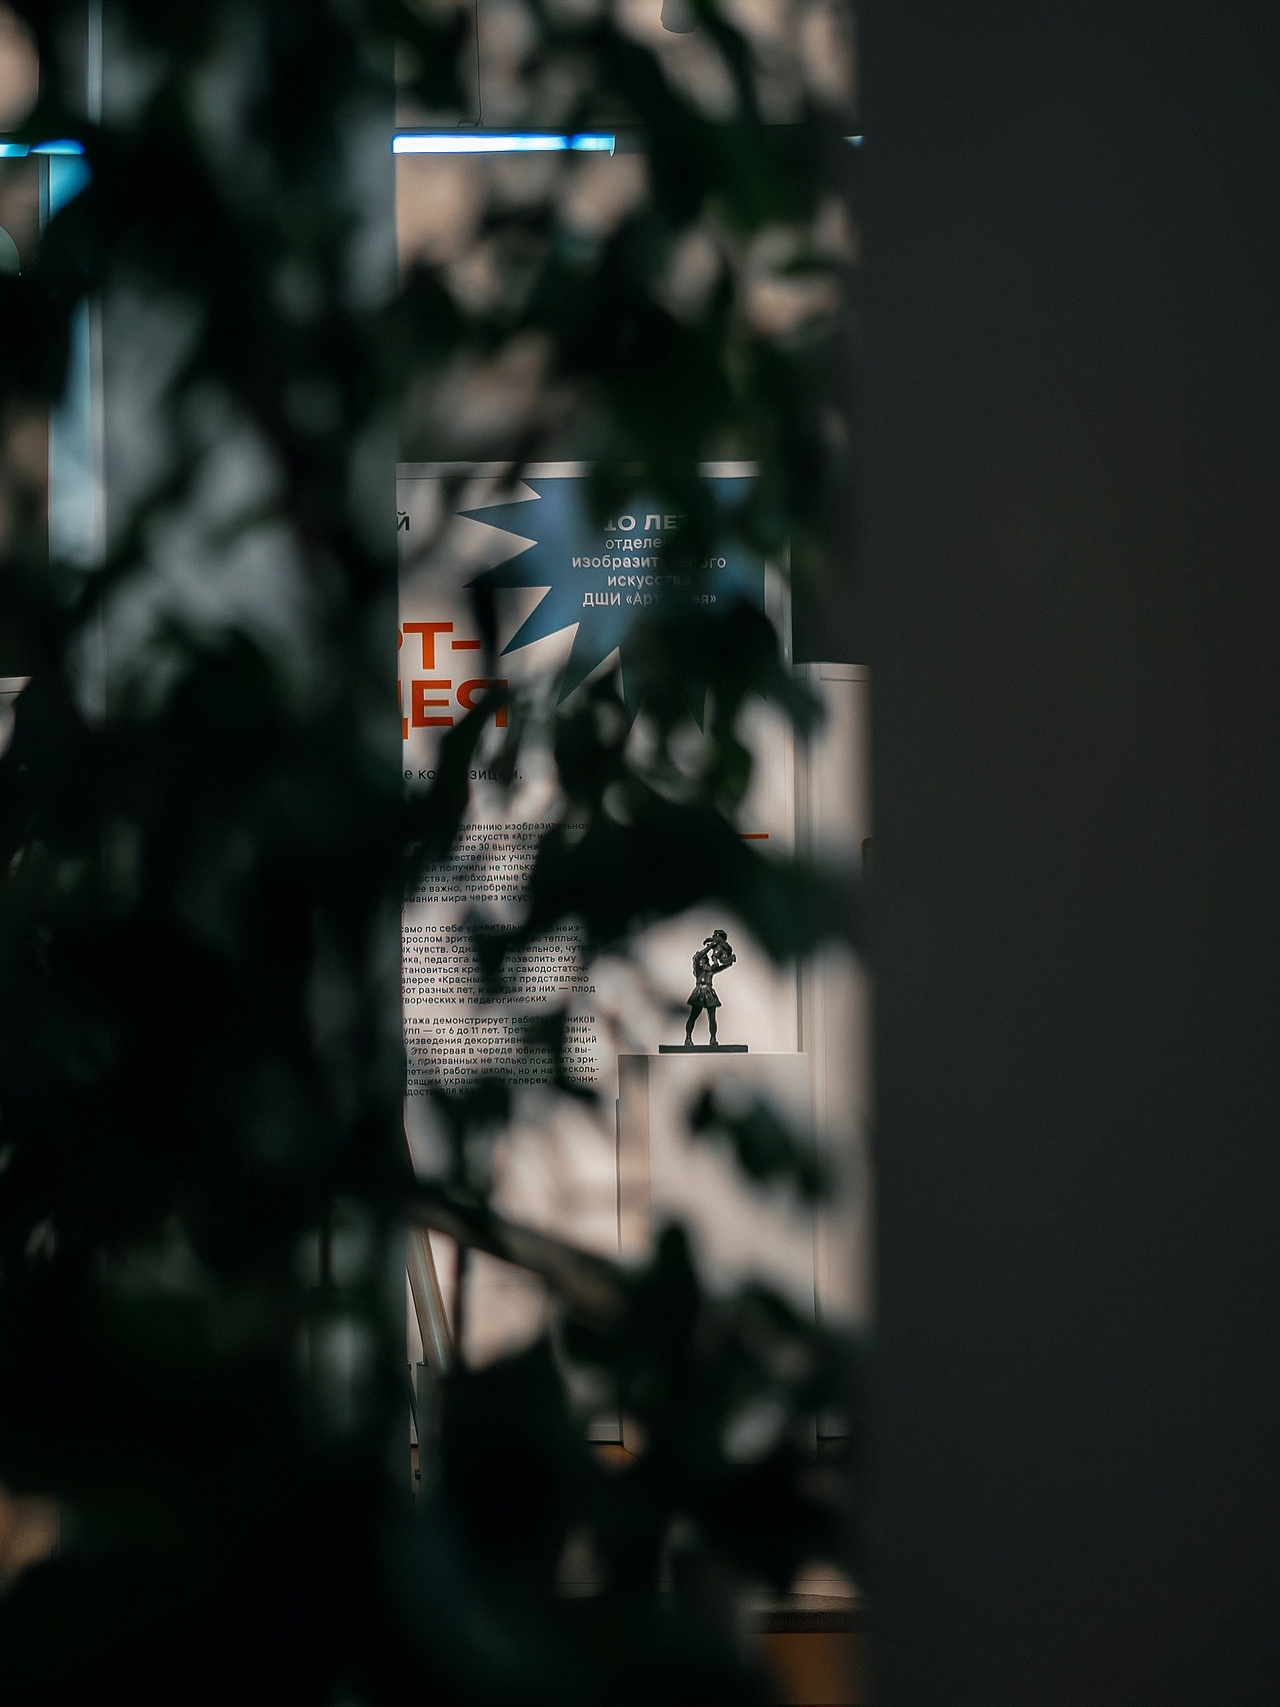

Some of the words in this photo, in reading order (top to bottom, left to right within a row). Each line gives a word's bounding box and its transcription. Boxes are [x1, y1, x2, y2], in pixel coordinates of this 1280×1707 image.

[605, 538, 667, 552] отделе
[582, 592, 621, 607] ДШИ
[398, 622, 481, 670] Т-
[398, 679, 508, 740] ЕЯ
[466, 834, 509, 843] искусств
[479, 843, 490, 851] 30
[439, 865, 487, 873] получили
[489, 864, 501, 872] не
[451, 873, 518, 883] необходимые
[429, 885, 462, 893] важно,
[465, 883, 518, 893] приобрели
[441, 896, 467, 904] мира
[469, 894, 499, 903] через
[439, 924, 463, 933] себе
[556, 925, 584, 933] неиз-
[413, 947, 449, 955] чувств.
[424, 956, 469, 965] педагога
[505, 955, 556, 964] позволить
[558, 956, 577, 965] ему
[519, 975, 590, 985] представлено
[418, 987, 454, 995] разных
[456, 987, 476, 995] лет,
[539, 985, 556, 993] них
[571, 985, 596, 994] плод
[467, 995, 547, 1005] педагогических
[432, 1017, 509, 1026] демонстрирует
[449, 1026, 455, 1035] 6
[456, 1028, 469, 1036] до
[471, 1026, 479, 1034] 11
[481, 1027, 500, 1035] лет.
[410, 1047, 428, 1055] Это
[430, 1047, 466, 1056] первая
[476, 1047, 513, 1055] череде
[574, 1046, 592, 1054] вы-
[417, 1057, 478, 1067] призванных
[480, 1057, 492, 1065] не
[494, 1056, 527, 1065] только
[577, 1057, 598, 1065] зри-
[443, 1066, 479, 1076] работы
[480, 1067, 516, 1076] школы,
[540, 1067, 553, 1075] на
